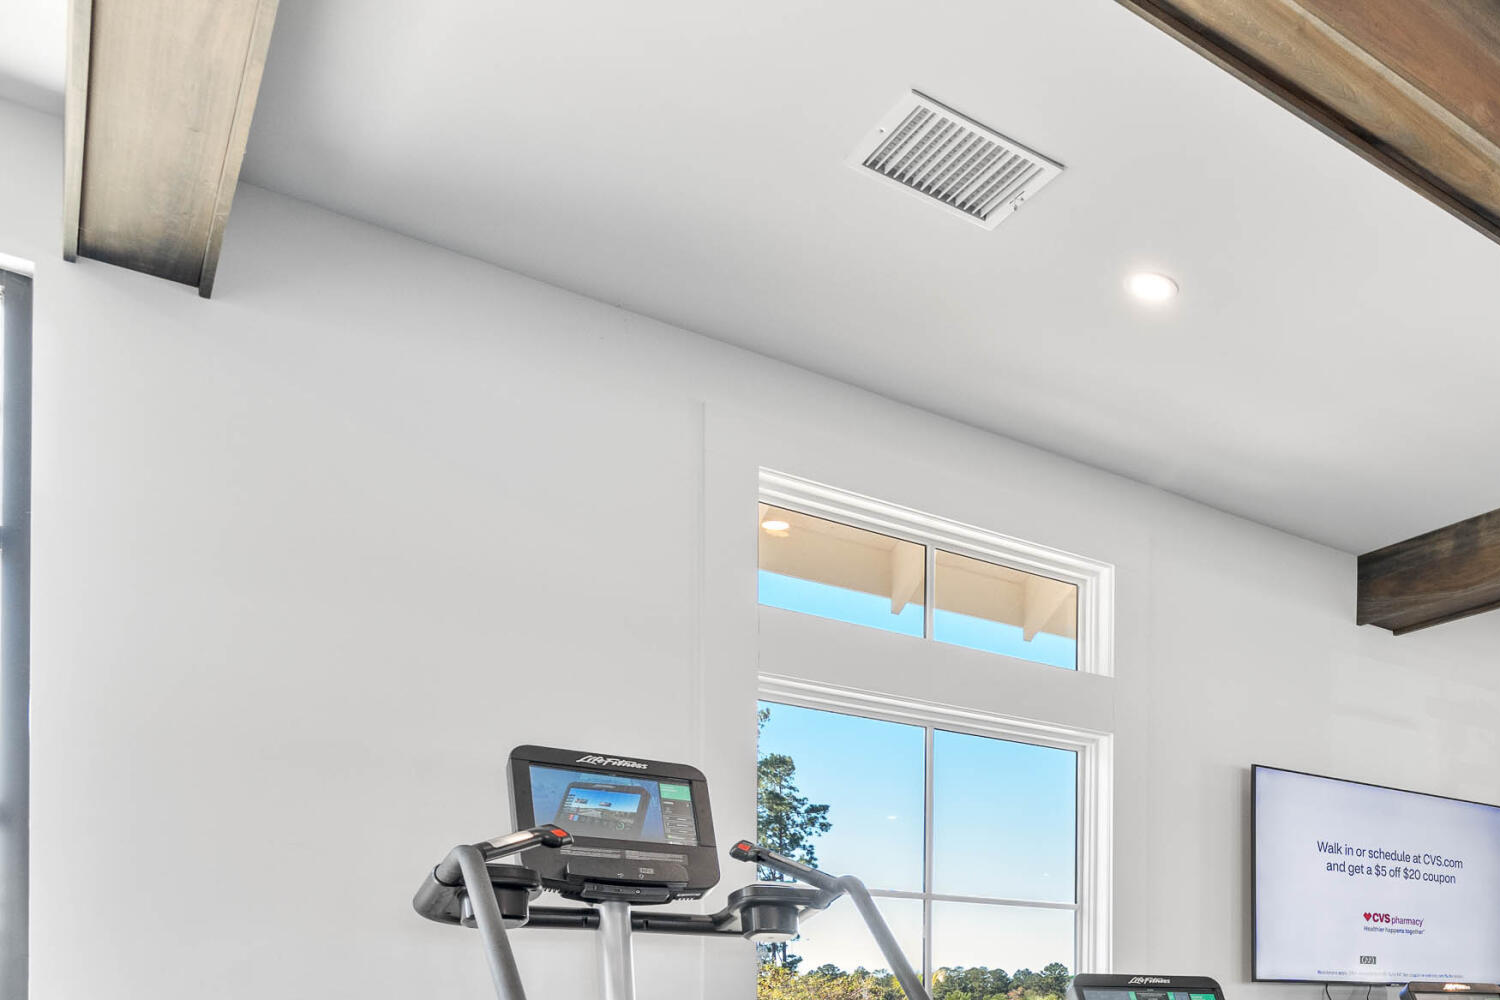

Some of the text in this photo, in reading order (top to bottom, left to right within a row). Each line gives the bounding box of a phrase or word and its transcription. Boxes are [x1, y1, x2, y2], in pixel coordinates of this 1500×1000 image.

[1317, 840, 1463, 869] Walk in or schedule at CVS.com
[1326, 861, 1456, 884] and get a $5 off $20 coupon
[1372, 912, 1424, 927] CVS pharmacy
